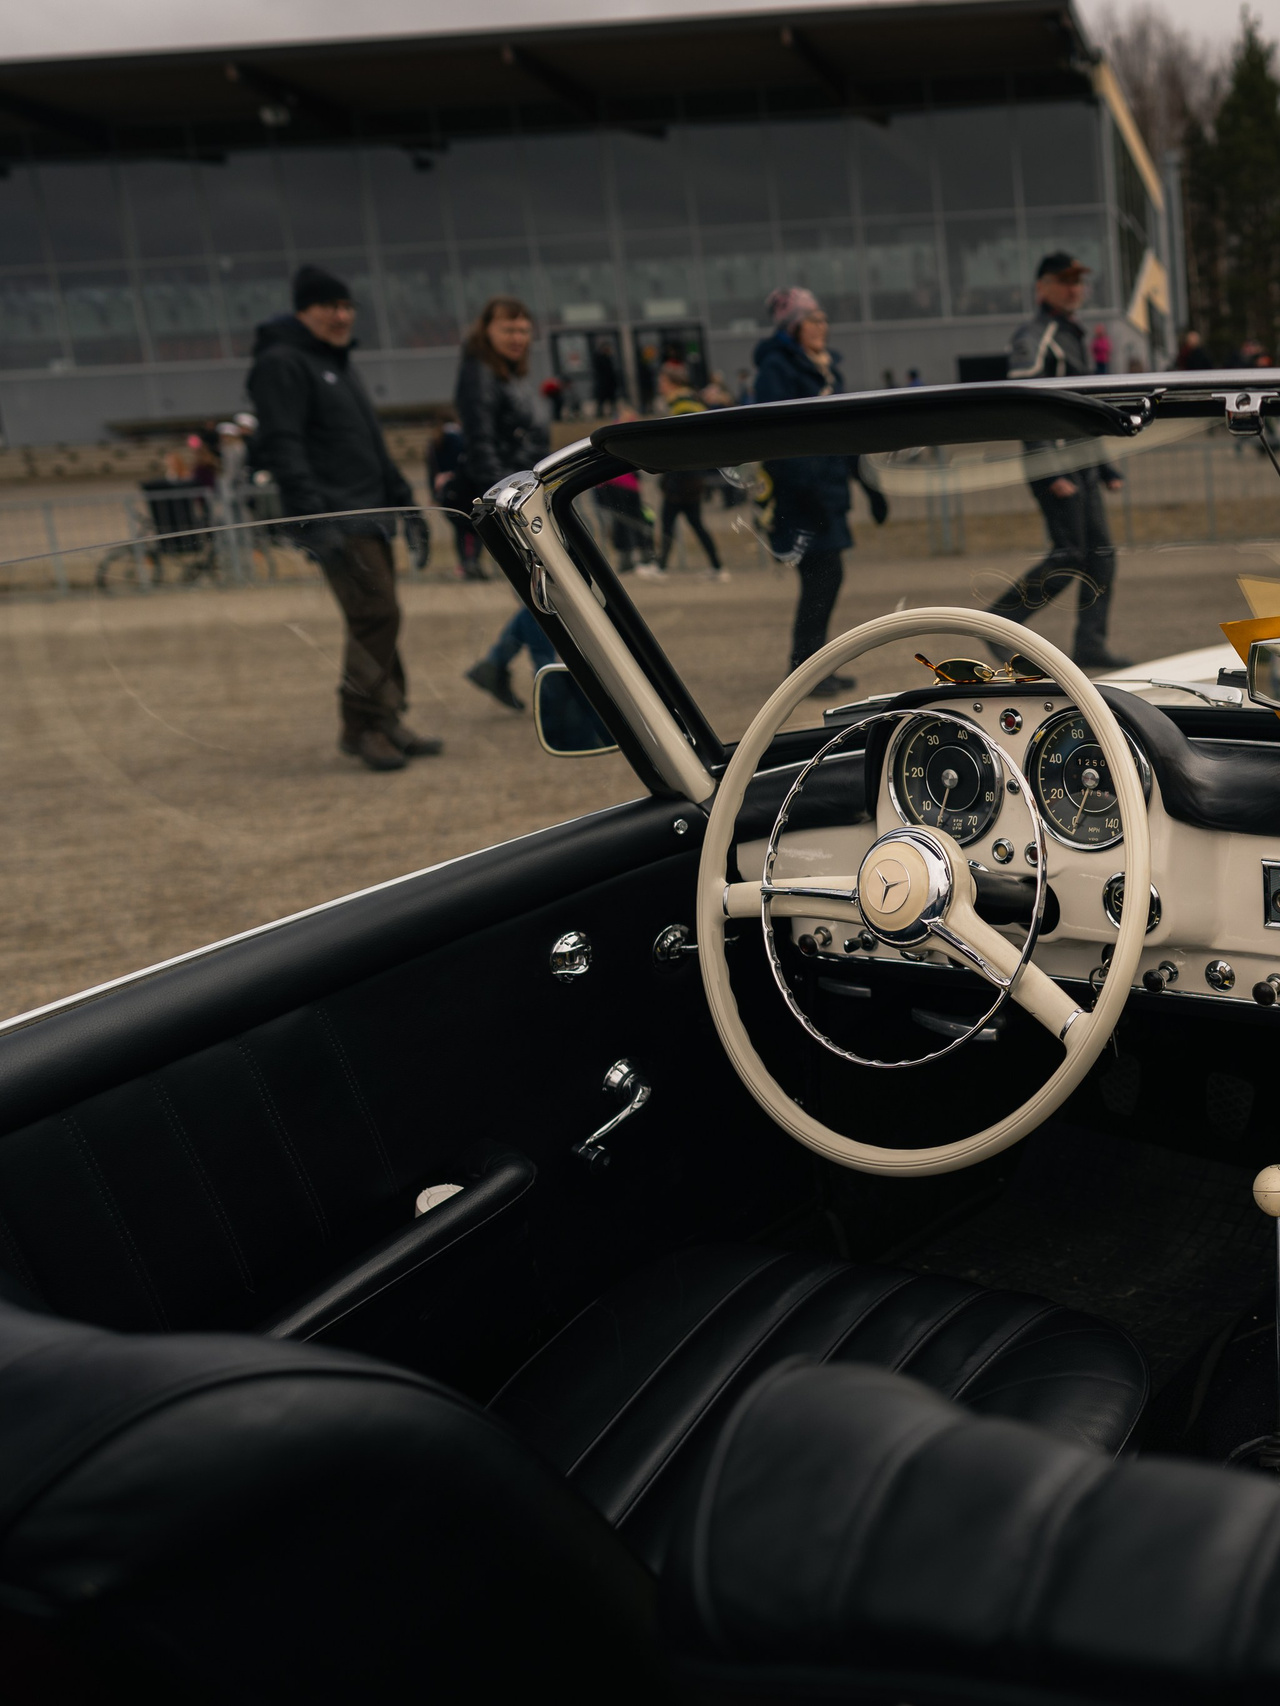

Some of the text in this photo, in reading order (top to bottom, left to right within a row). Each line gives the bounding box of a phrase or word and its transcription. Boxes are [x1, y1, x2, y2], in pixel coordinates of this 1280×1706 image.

[957, 730, 968, 740] 40
[1071, 729, 1084, 739] 60
[927, 735, 939, 745] 30
[982, 754, 991, 764] 50
[1049, 753, 1062, 764] 40
[911, 767, 924, 778] 20
[985, 791, 994, 802] 60
[1050, 788, 1064, 799] 20
[922, 801, 932, 811] 10
[967, 815, 978, 826] 70
[1105, 818, 1119, 829] 140
